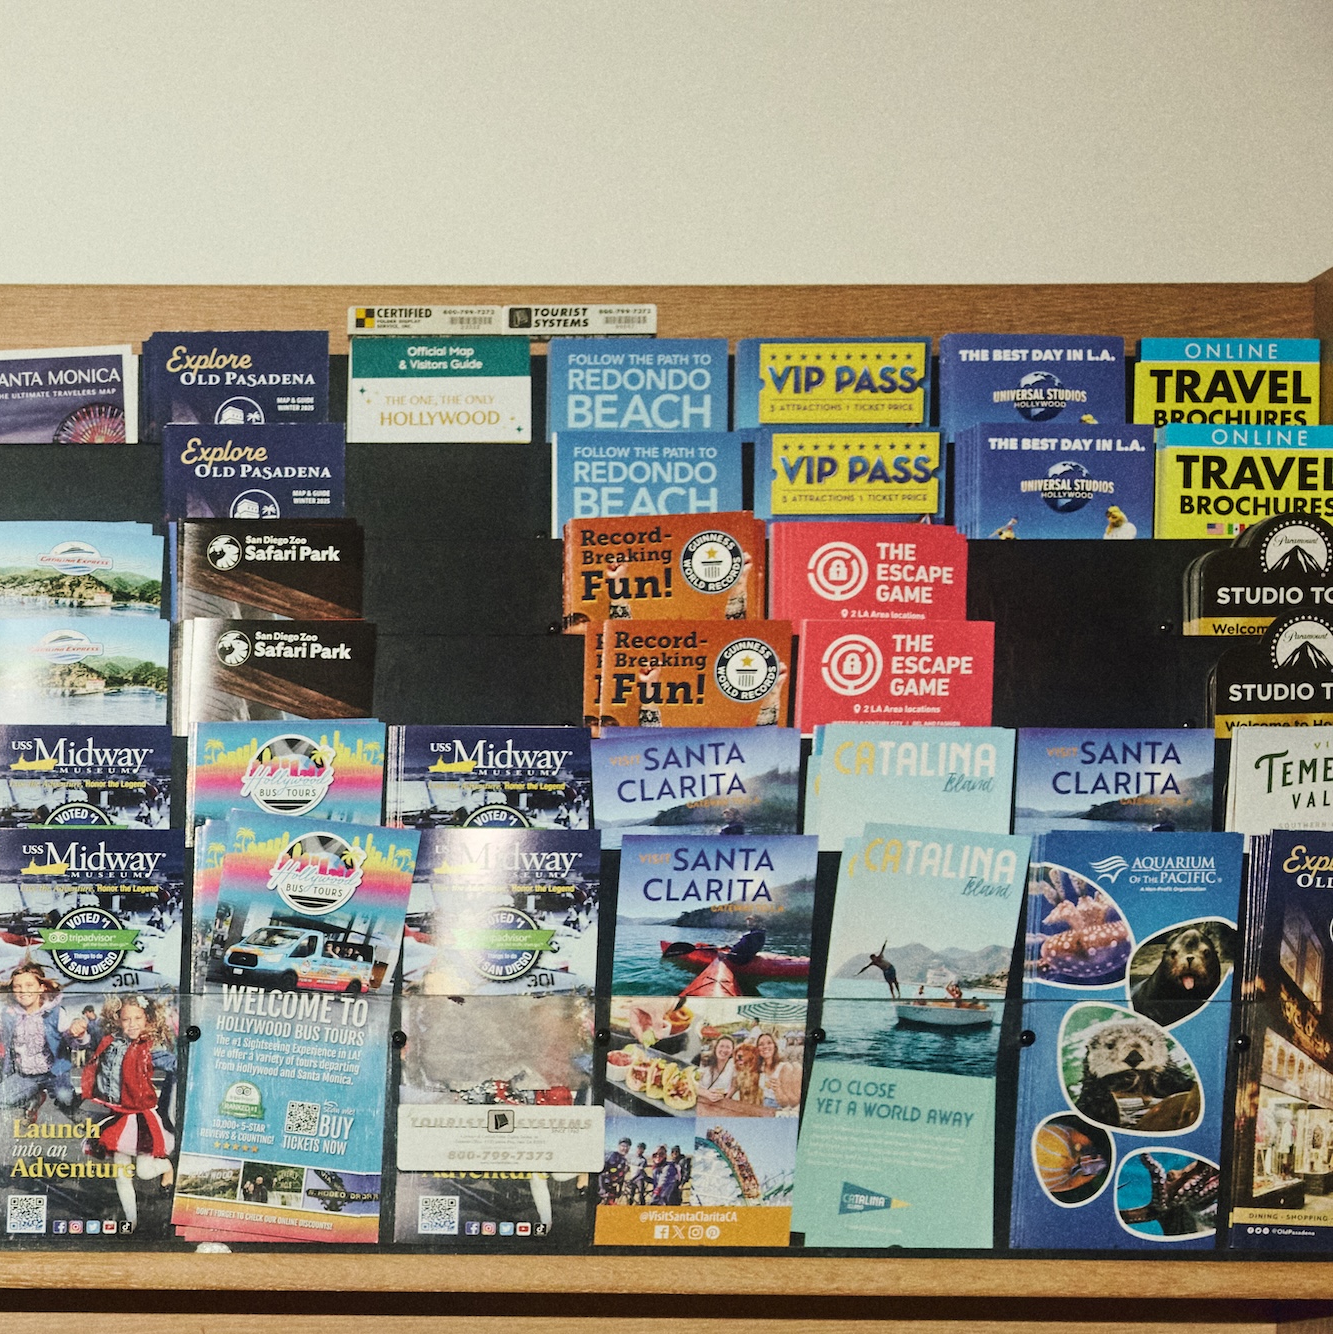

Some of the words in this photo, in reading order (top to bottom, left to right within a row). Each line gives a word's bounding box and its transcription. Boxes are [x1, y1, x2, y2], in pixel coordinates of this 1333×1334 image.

[377, 309, 432, 318] CERTIFIED
[534, 308, 588, 317] TOURIST
[534, 318, 589, 328] SYSTEMS
[960, 350, 988, 362] THE
[993, 350, 1028, 362] BEST
[1032, 350, 1063, 362] DAY
[1067, 350, 1083, 362] IN
[1086, 350, 1116, 362] L.A.
[1185, 343, 1278, 360] ONLINE
[167, 347, 252, 383] Explore
[48, 367, 121, 386] MONICA
[180, 372, 220, 386] OLD
[226, 371, 316, 386] PASADENA
[568, 369, 710, 390] REDONDO
[768, 366, 824, 393] VIP
[836, 366, 919, 393] PASS
[1150, 370, 1312, 404] TRAVEL
[380, 411, 500, 425] HOLLYWOOD
[567, 394, 712, 427] BEACH
[581, 530, 671, 546] Record-
[245, 545, 296, 562] Safari
[299, 545, 340, 562] Park
[582, 548, 671, 567] Breaking
[876, 543, 916, 560] THE
[876, 564, 953, 584] ESCAPE
[581, 572, 672, 601] Fun!
[876, 585, 933, 603] GAME
[222, 985, 334, 1022] WELCOME
[340, 999, 367, 1027] TO
[816, 1098, 842, 1114] YET
[848, 1101, 857, 1117] A
[862, 1102, 921, 1123] WORLD
[926, 1110, 974, 1128] AWAY
[11, 1159, 134, 1180] Adventure
